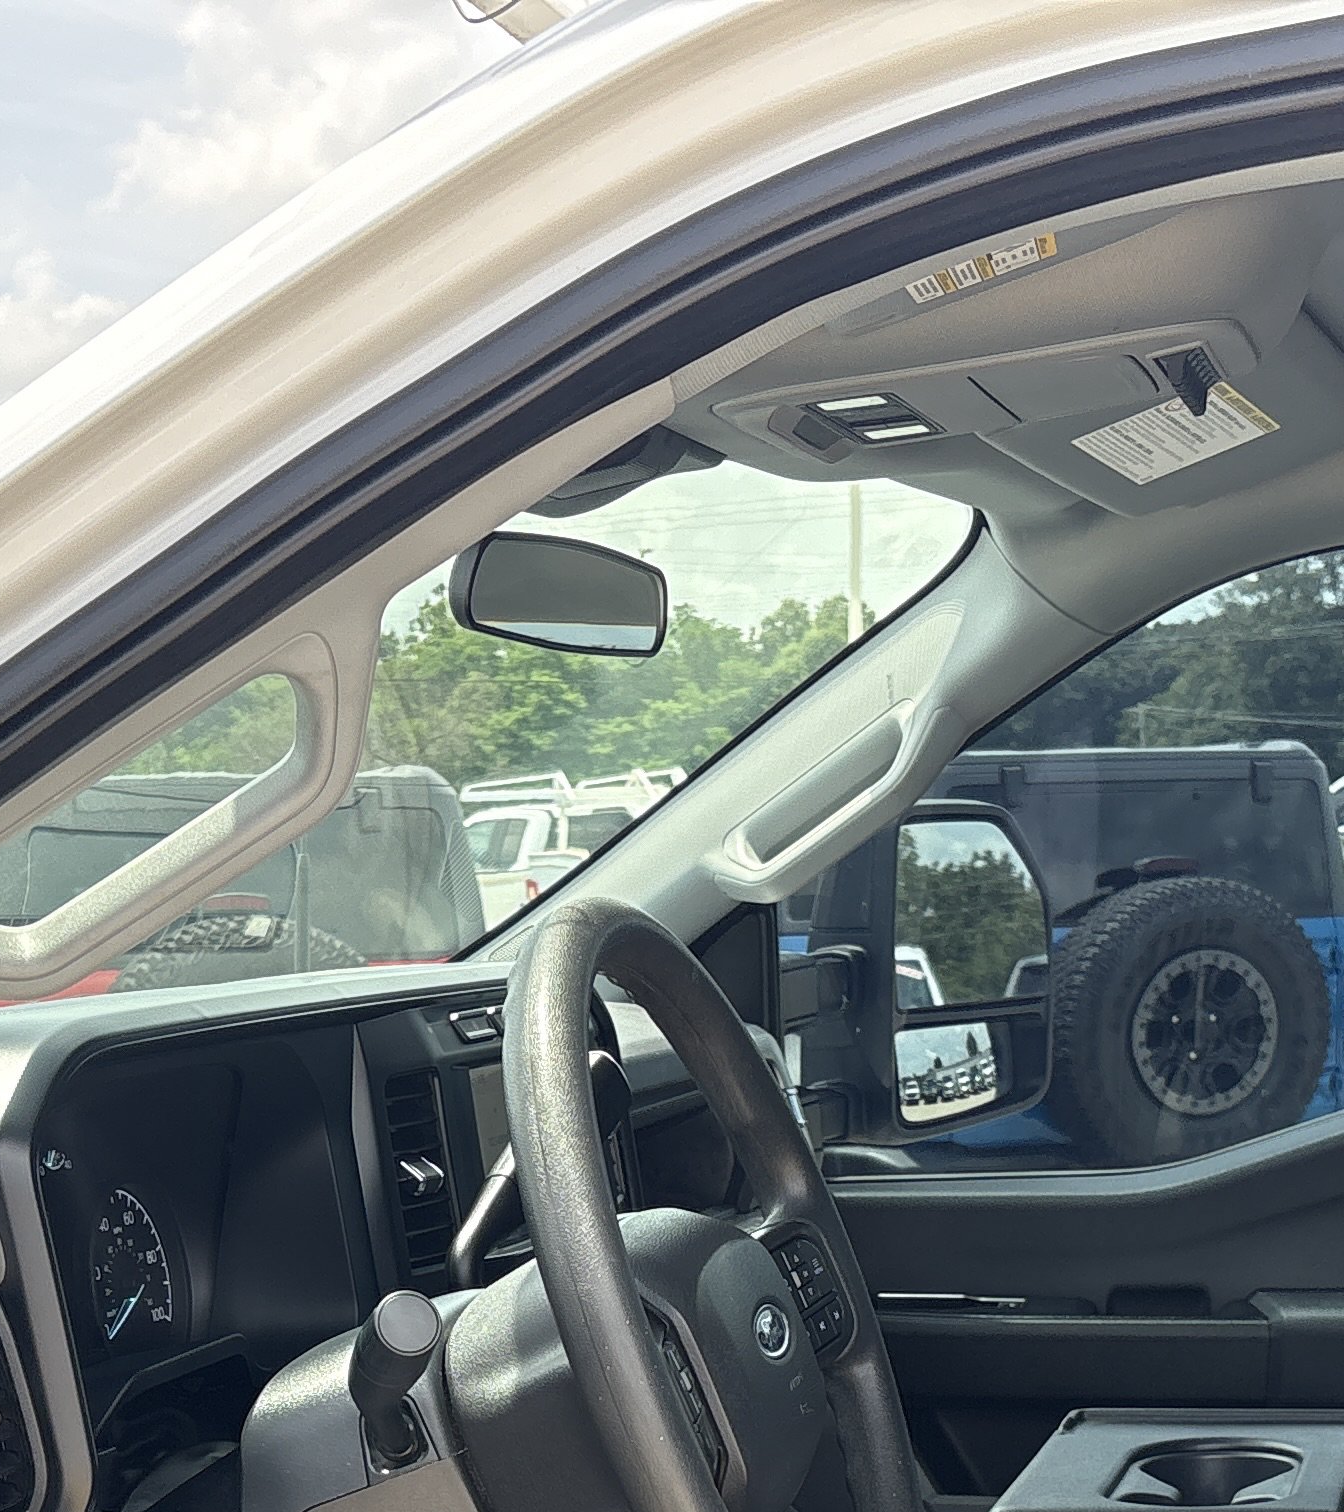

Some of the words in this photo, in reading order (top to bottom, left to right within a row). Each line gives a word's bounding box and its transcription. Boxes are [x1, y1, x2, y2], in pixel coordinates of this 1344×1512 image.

[99, 1217, 110, 1232] 40
[123, 1210, 135, 1226] 60
[146, 1249, 157, 1265] 80
[151, 1306, 165, 1322] 100
